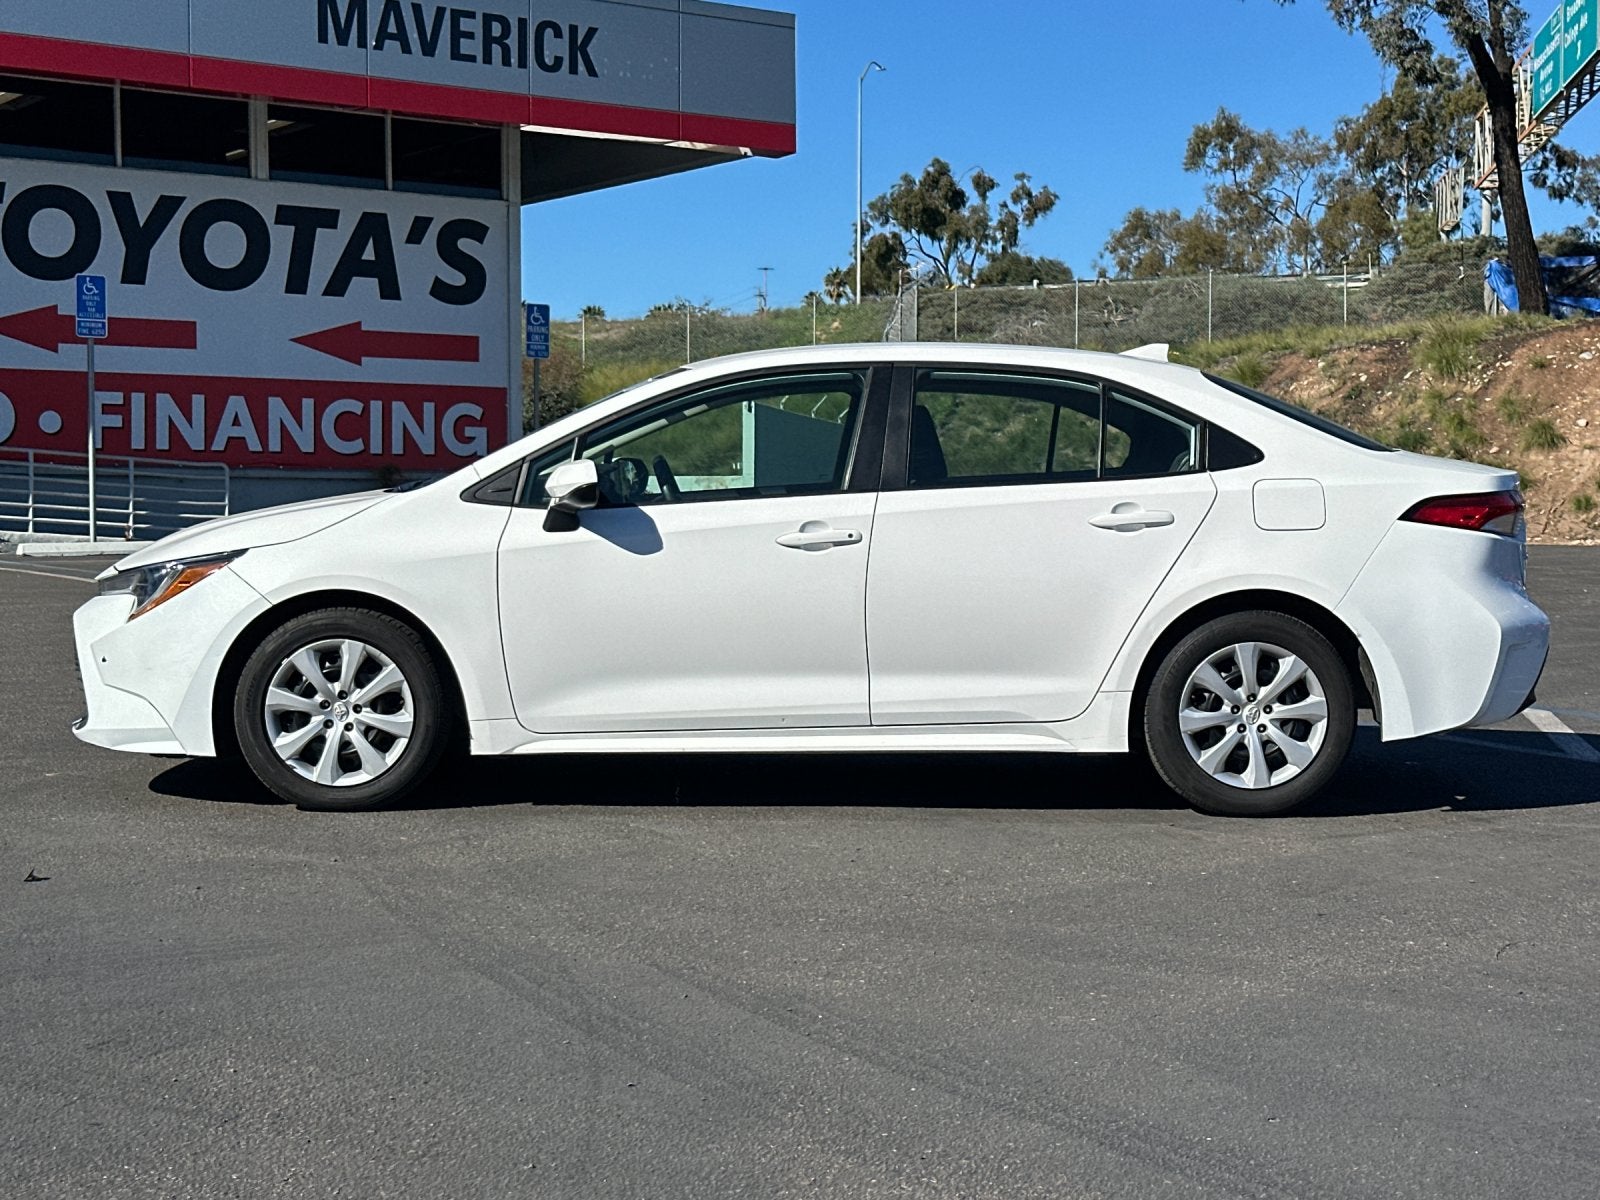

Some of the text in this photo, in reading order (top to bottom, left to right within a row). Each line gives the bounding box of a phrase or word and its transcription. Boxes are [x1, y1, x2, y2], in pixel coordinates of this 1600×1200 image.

[316, 0, 599, 78] MAVERICK
[0, 182, 490, 306] OYOTA'S
[94, 391, 488, 457] FINANCING
